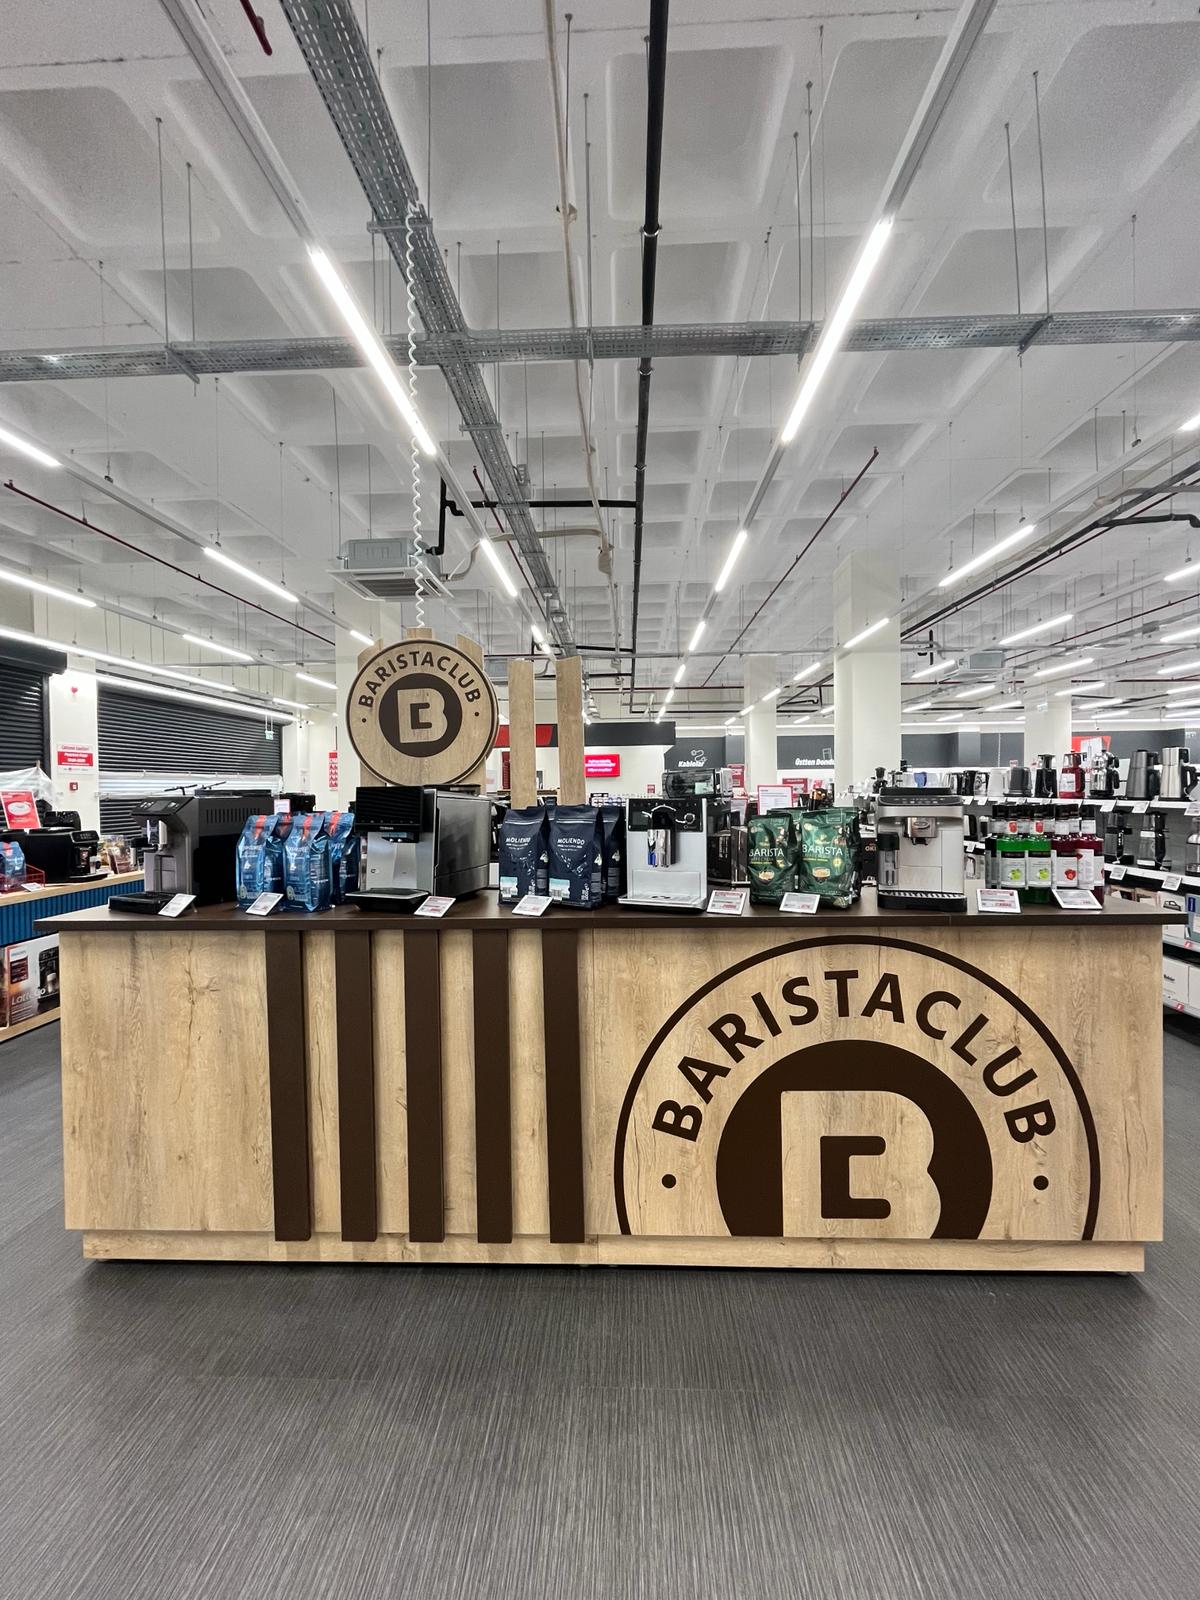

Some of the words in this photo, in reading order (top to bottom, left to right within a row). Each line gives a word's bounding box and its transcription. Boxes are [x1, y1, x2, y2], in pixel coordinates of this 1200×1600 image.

[358, 651, 481, 708] BARISTACLUB
[557, 837, 585, 846] MOLIENDO
[749, 847, 785, 857] BARISTA
[802, 844, 843, 856] BARISTA
[651, 969, 1057, 1144] BARISTACLUB
